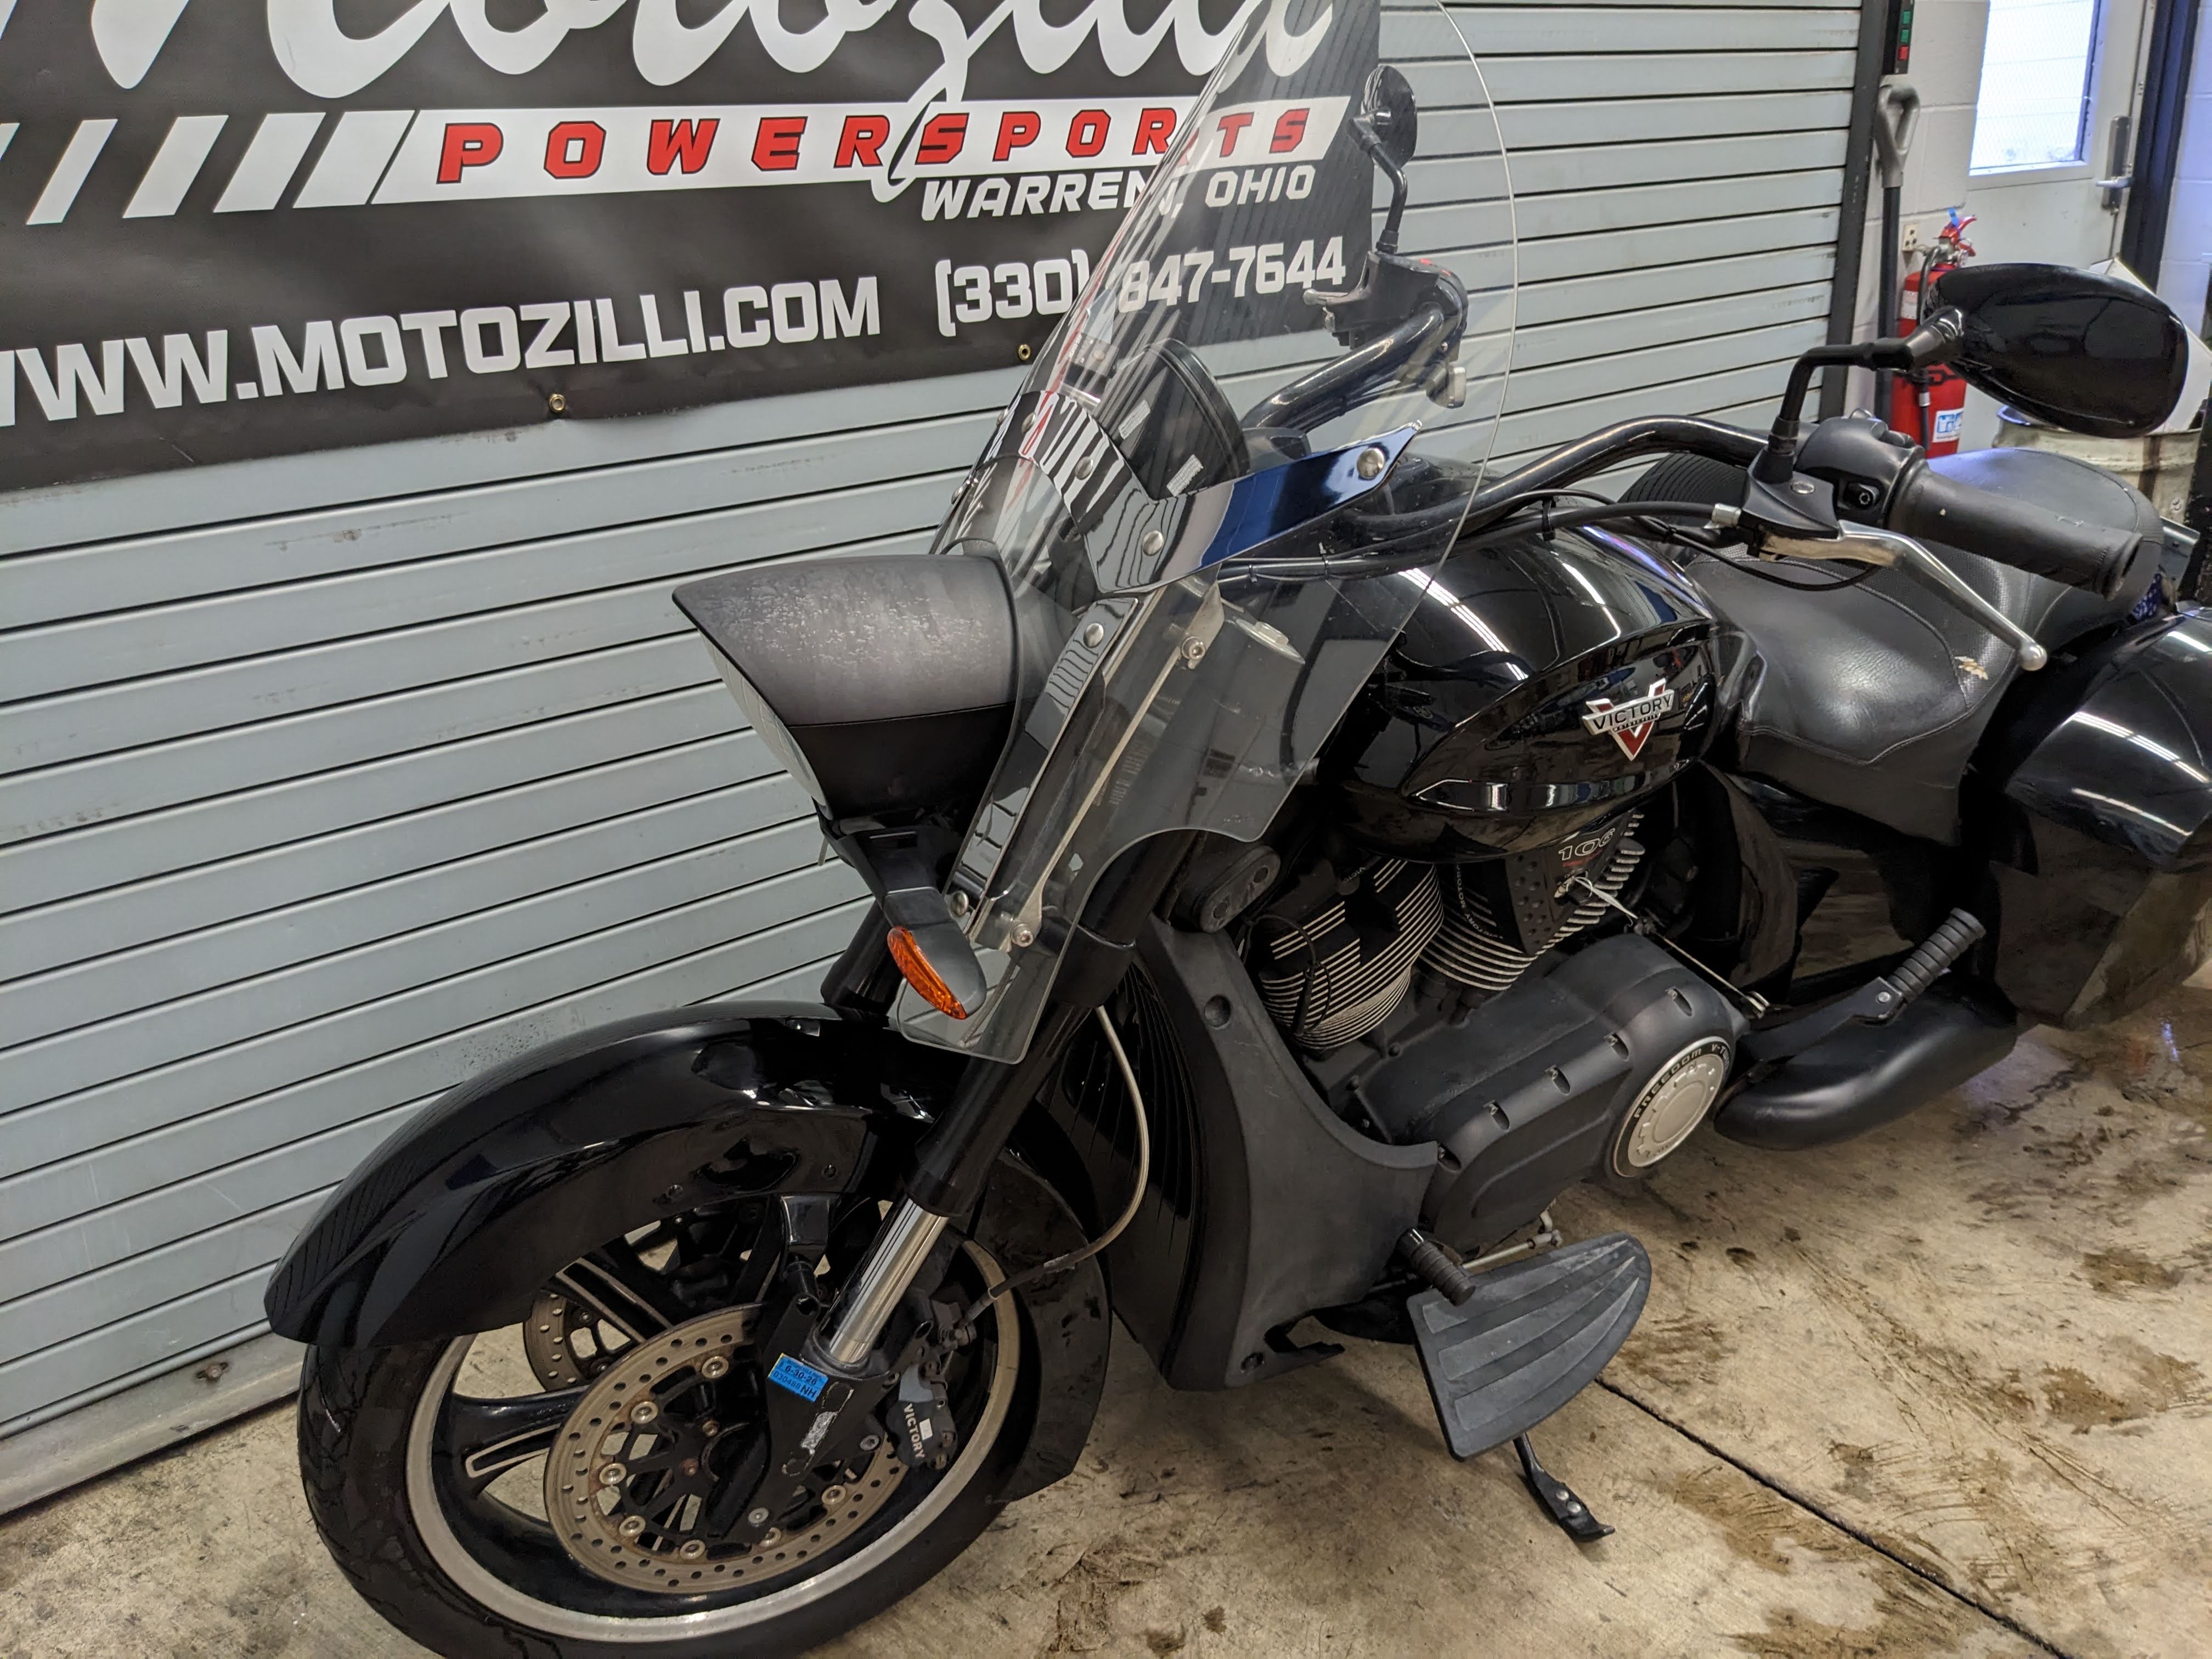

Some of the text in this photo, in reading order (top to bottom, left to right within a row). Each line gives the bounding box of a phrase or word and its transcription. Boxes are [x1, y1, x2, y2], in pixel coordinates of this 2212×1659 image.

[437, 109, 1310, 184] POWERSPORTS
[1205, 165, 1316, 207] OHIO
[1118, 235, 1346, 314] 847-7644
[0, 276, 880, 427] WW.MOTOZILLI.COM
[1593, 695, 1671, 730] VICTORY
[1558, 827, 1616, 861] 106
[800, 1384, 817, 1398] NH
[904, 1403, 926, 1458] VICTORY
